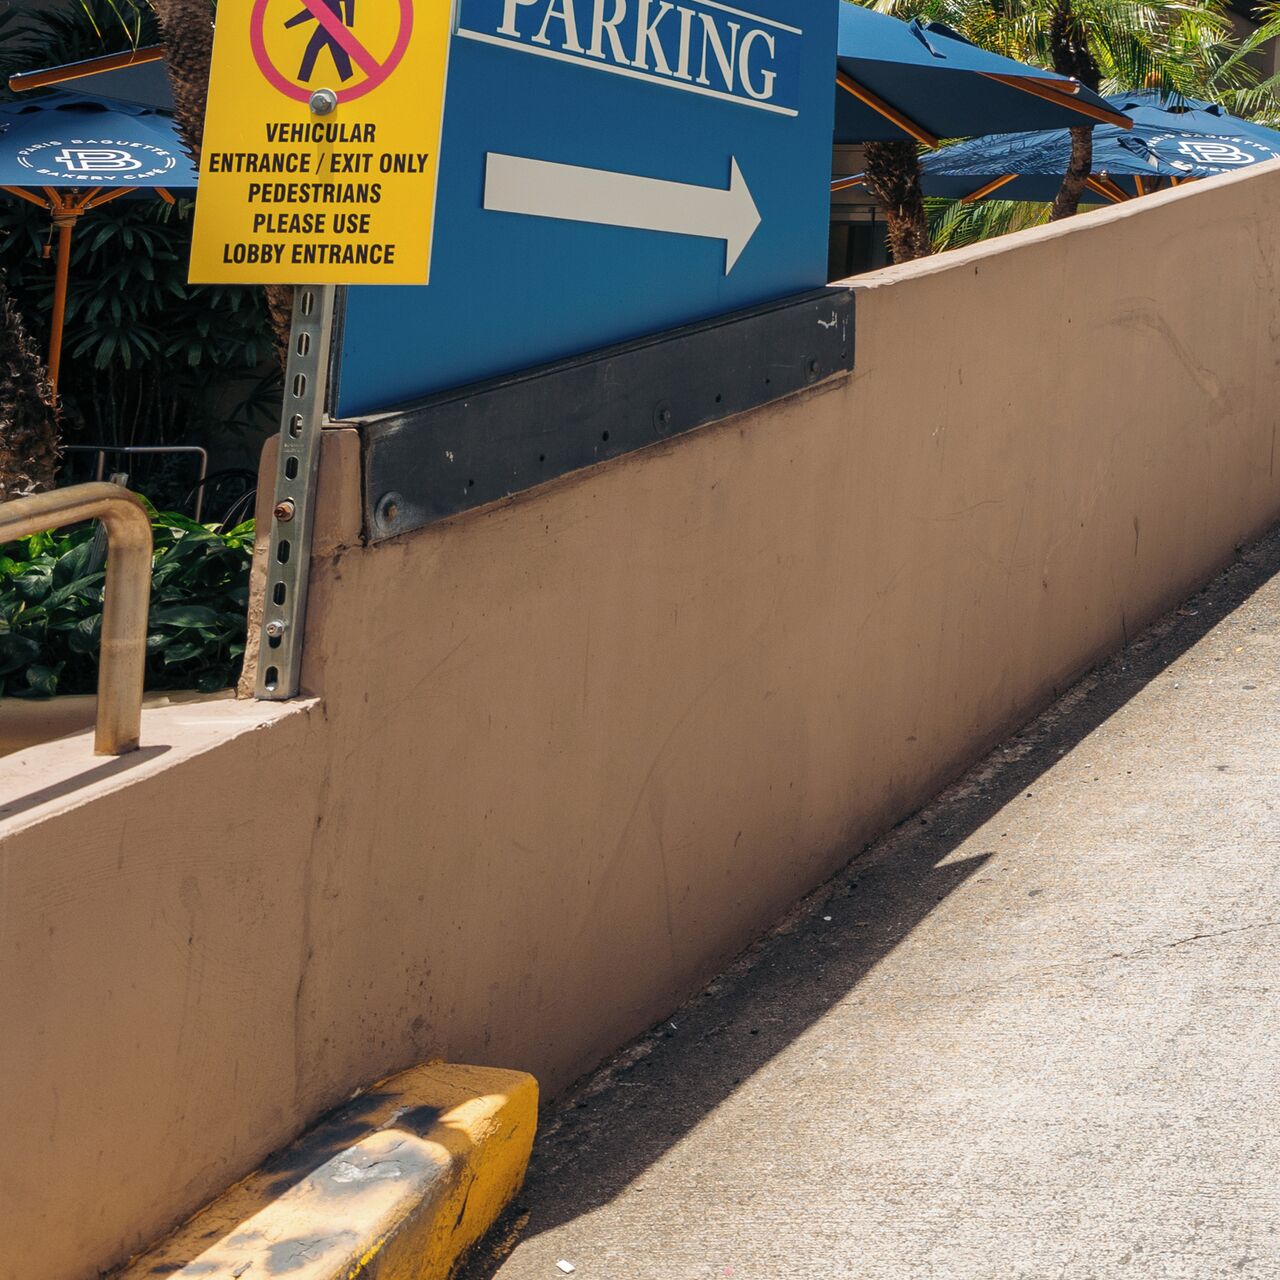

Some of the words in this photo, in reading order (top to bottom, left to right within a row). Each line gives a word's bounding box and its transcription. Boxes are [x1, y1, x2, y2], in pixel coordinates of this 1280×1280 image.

[266, 123, 376, 143] VEHICULAR
[1181, 133, 1270, 152] BAGUETTE
[18, 140, 62, 156] PARIS
[71, 139, 170, 156] BAGUETTE
[208, 153, 311, 173] ENTRANCE
[330, 153, 373, 173] EXIT
[379, 153, 429, 173] ONLY
[36, 169, 116, 181] BAKERY
[248, 183, 382, 203] PEDESTRIANS
[253, 213, 326, 233] PLEASE
[333, 213, 371, 233] USE
[223, 243, 285, 264] LOBBY
[291, 244, 395, 264] ENTRANCE
